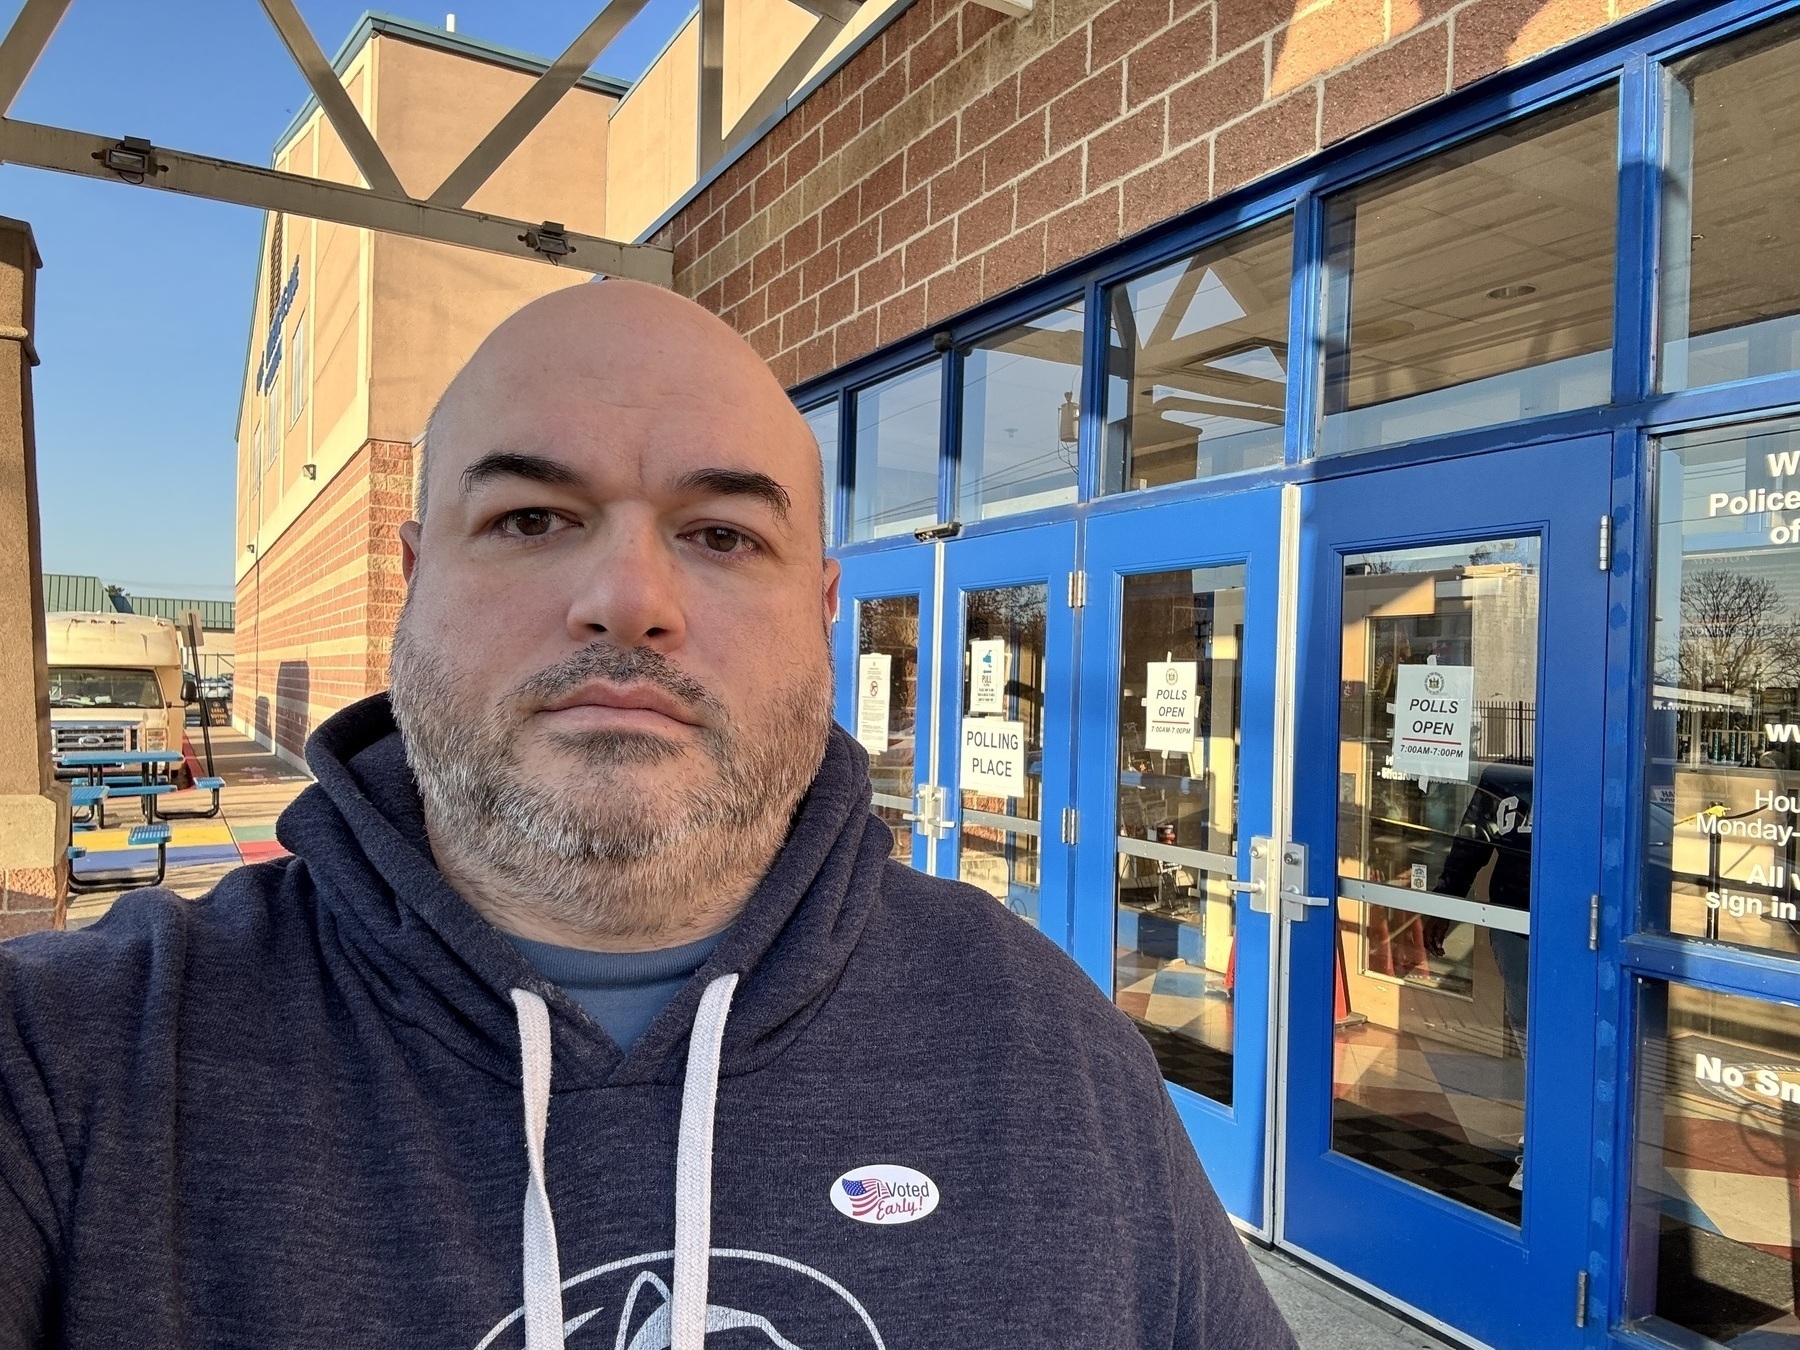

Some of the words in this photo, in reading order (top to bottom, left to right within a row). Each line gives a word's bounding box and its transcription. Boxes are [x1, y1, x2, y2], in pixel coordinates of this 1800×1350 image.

[1709, 488, 1800, 517] Police
[1156, 689, 1188, 700] POLLS
[1158, 706, 1185, 718] OPEN
[1409, 698, 1459, 714] POLLS
[1151, 726, 1191, 735] 7:00AM-7:00PM
[1412, 720, 1454, 736] OPEN
[1765, 723, 1800, 744] w
[966, 730, 1019, 751] POLLING
[1400, 744, 1464, 758] 7:00AM-7:00PM
[972, 757, 1012, 778] PLACE
[1745, 864, 1784, 888] All
[1705, 889, 1762, 917] sign
[1771, 896, 1797, 920] in
[1695, 1053, 1744, 1087] No
[877, 1182, 881, 1197] I
[886, 1181, 930, 1197] Voted
[876, 1197, 923, 1220] Early!
